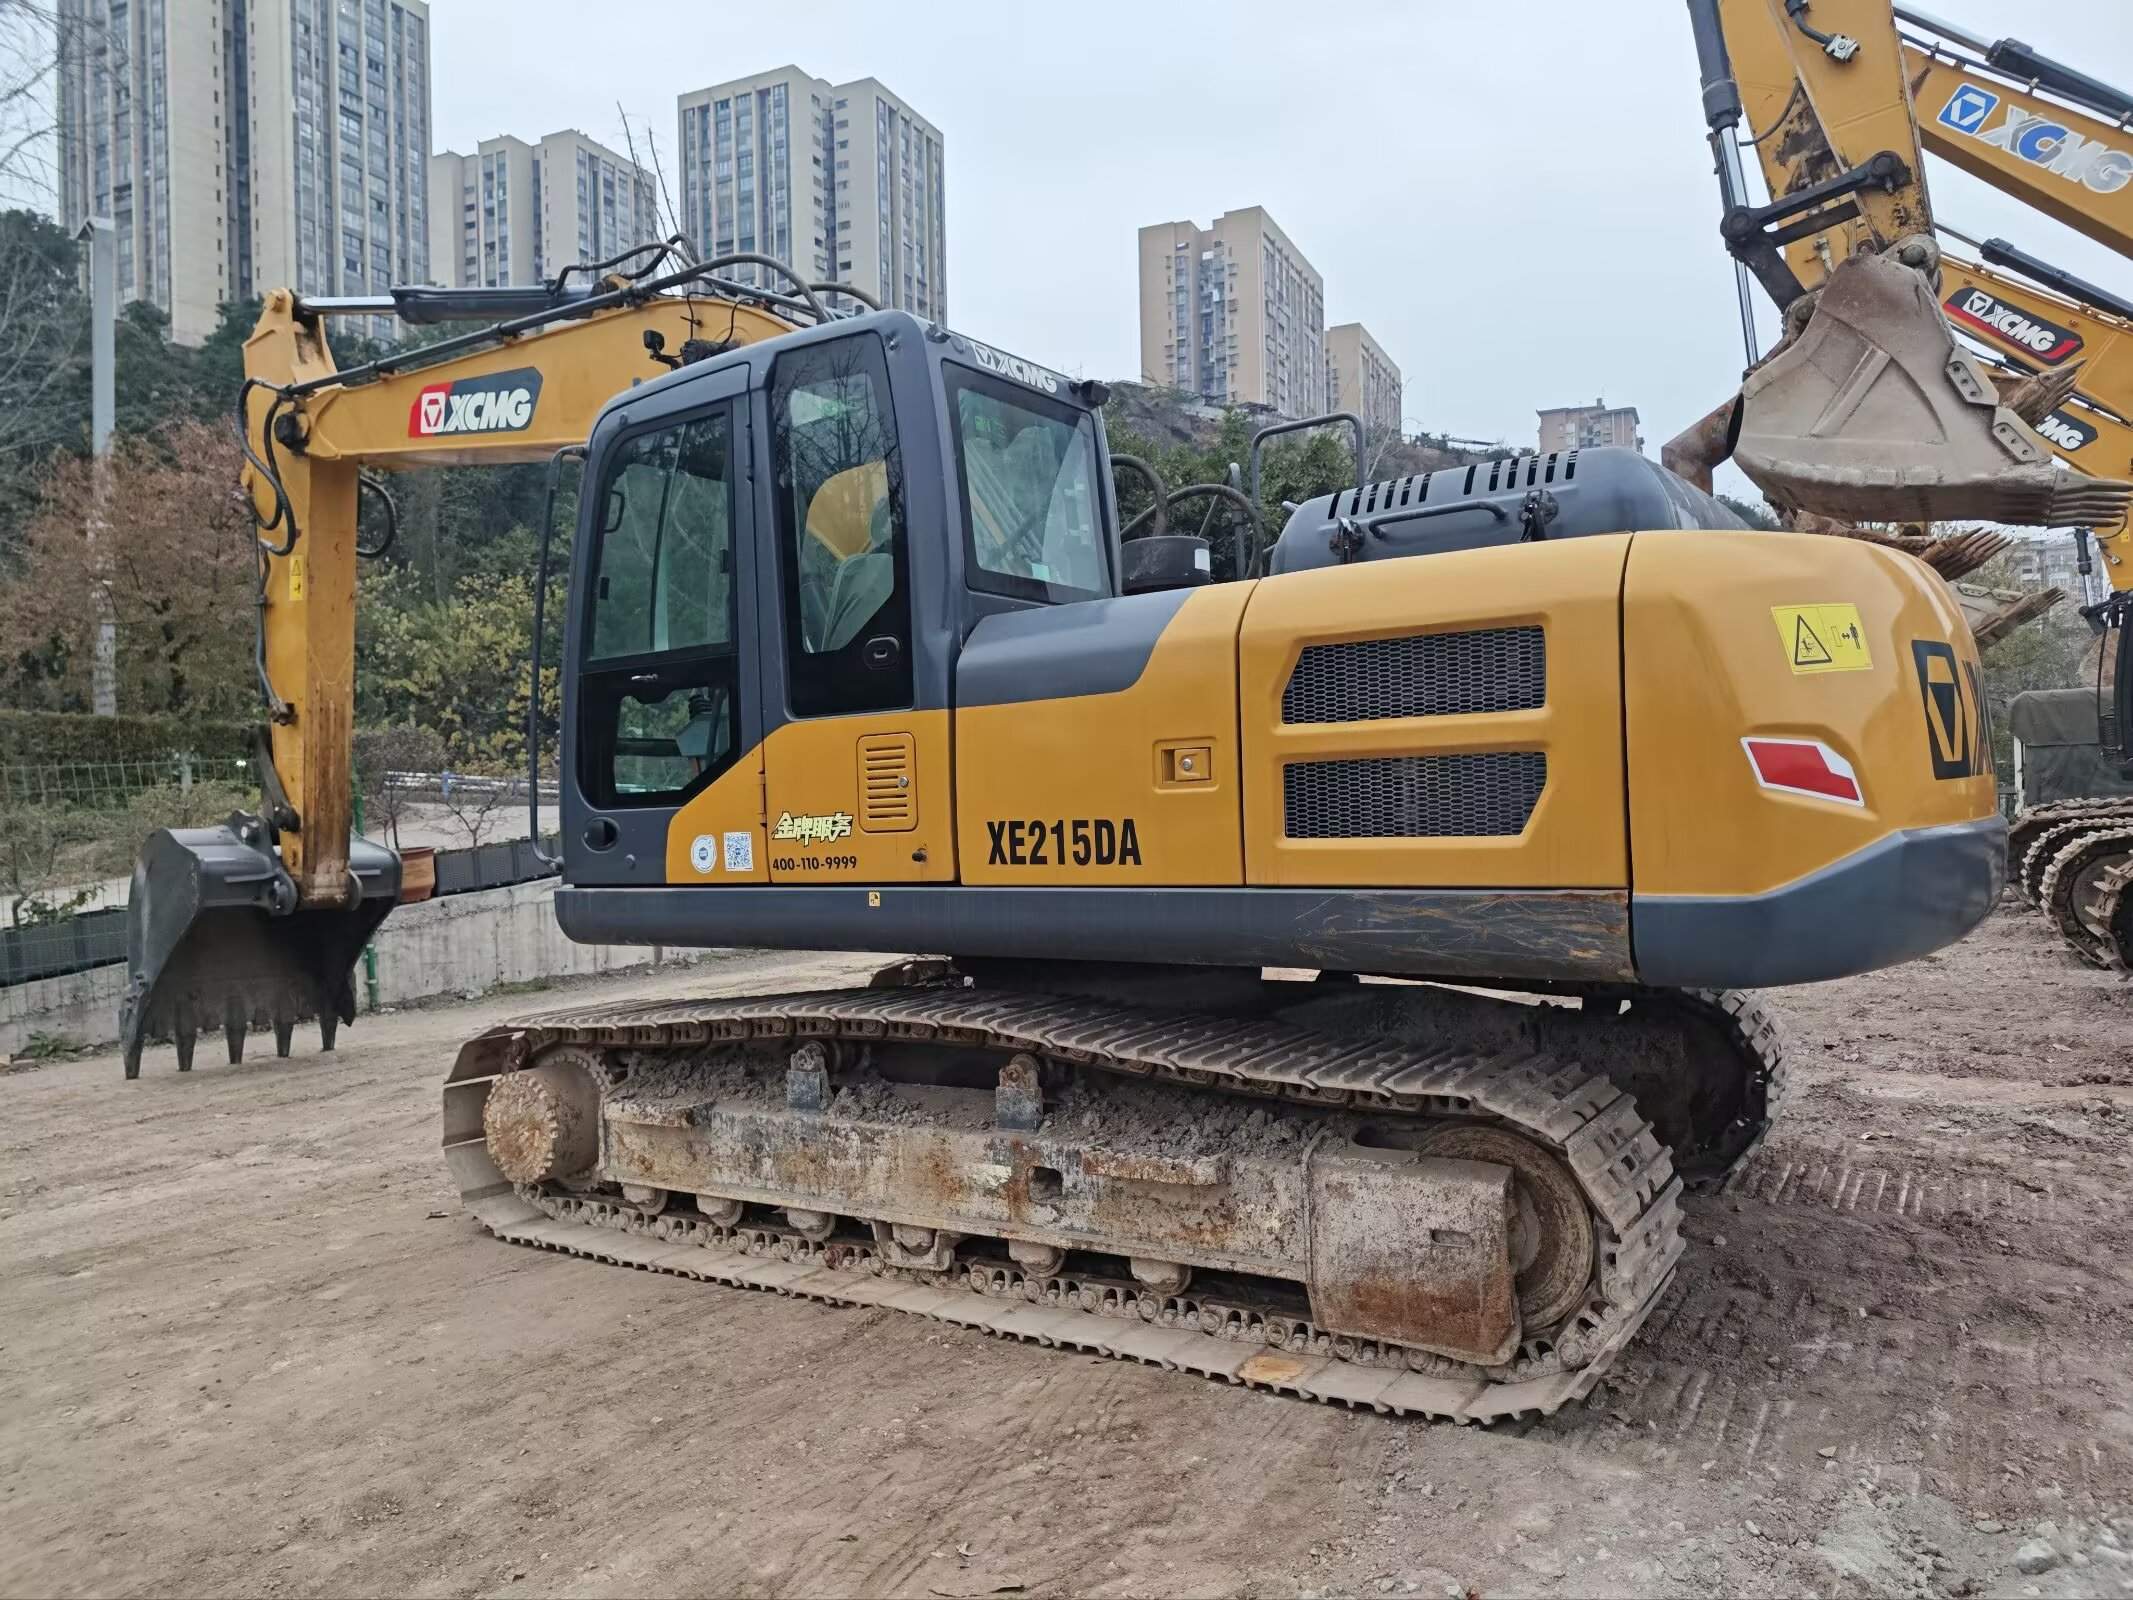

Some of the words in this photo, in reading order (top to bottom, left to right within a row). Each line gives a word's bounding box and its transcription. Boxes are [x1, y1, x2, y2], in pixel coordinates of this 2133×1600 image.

[1974, 104, 2133, 193] XCMG
[1982, 303, 2055, 352] XCMG
[996, 352, 1058, 394] XCMG
[444, 388, 532, 432] XCMG
[772, 811, 853, 847] 金牌服务
[986, 818, 1143, 866] XE215DA
[772, 855, 857, 871] 400-110-9999
